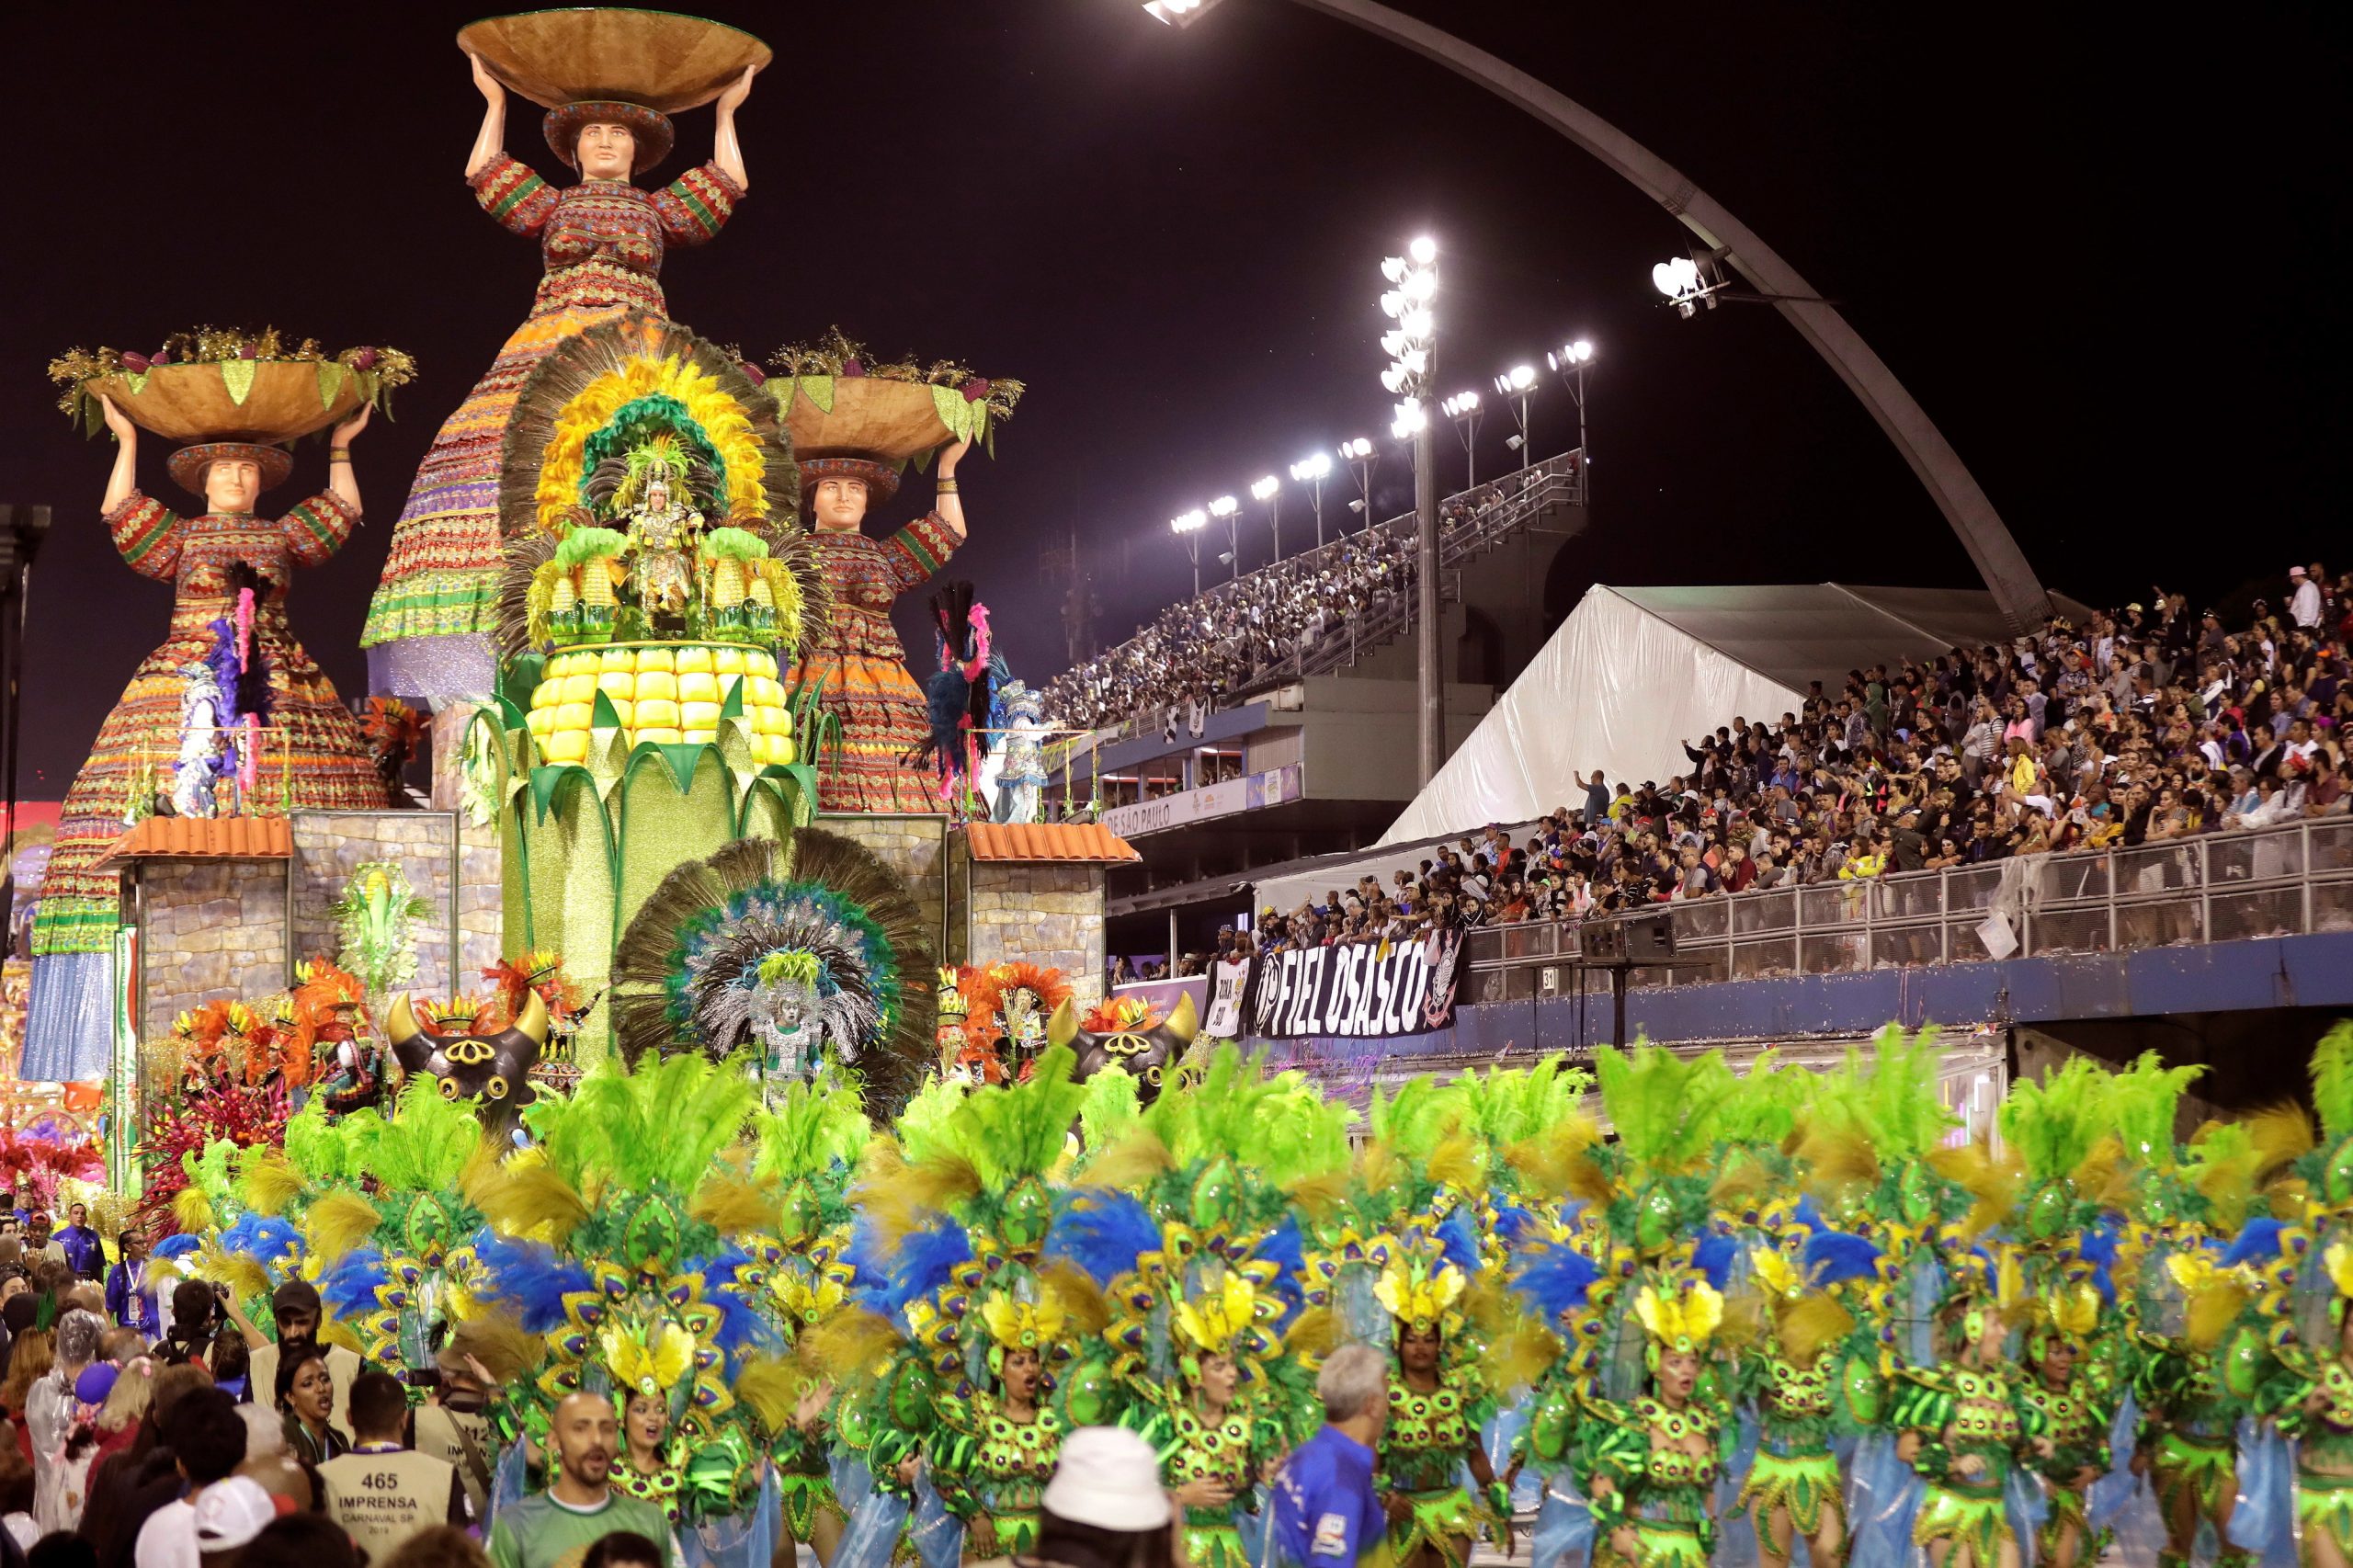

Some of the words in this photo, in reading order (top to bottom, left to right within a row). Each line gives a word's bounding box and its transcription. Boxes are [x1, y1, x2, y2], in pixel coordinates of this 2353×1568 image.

[1120, 808, 1139, 835] SÃO
[1141, 803, 1170, 830] PAULO
[1544, 972, 1553, 986] 31
[1272, 946, 1326, 1036] FIEL
[1326, 939, 1428, 1036] OSASCO
[361, 1472, 398, 1489] 465
[338, 1496, 417, 1509] IMPRENSA
[342, 1514, 396, 1523] CARNAVAL
[400, 1514, 414, 1523] SP
